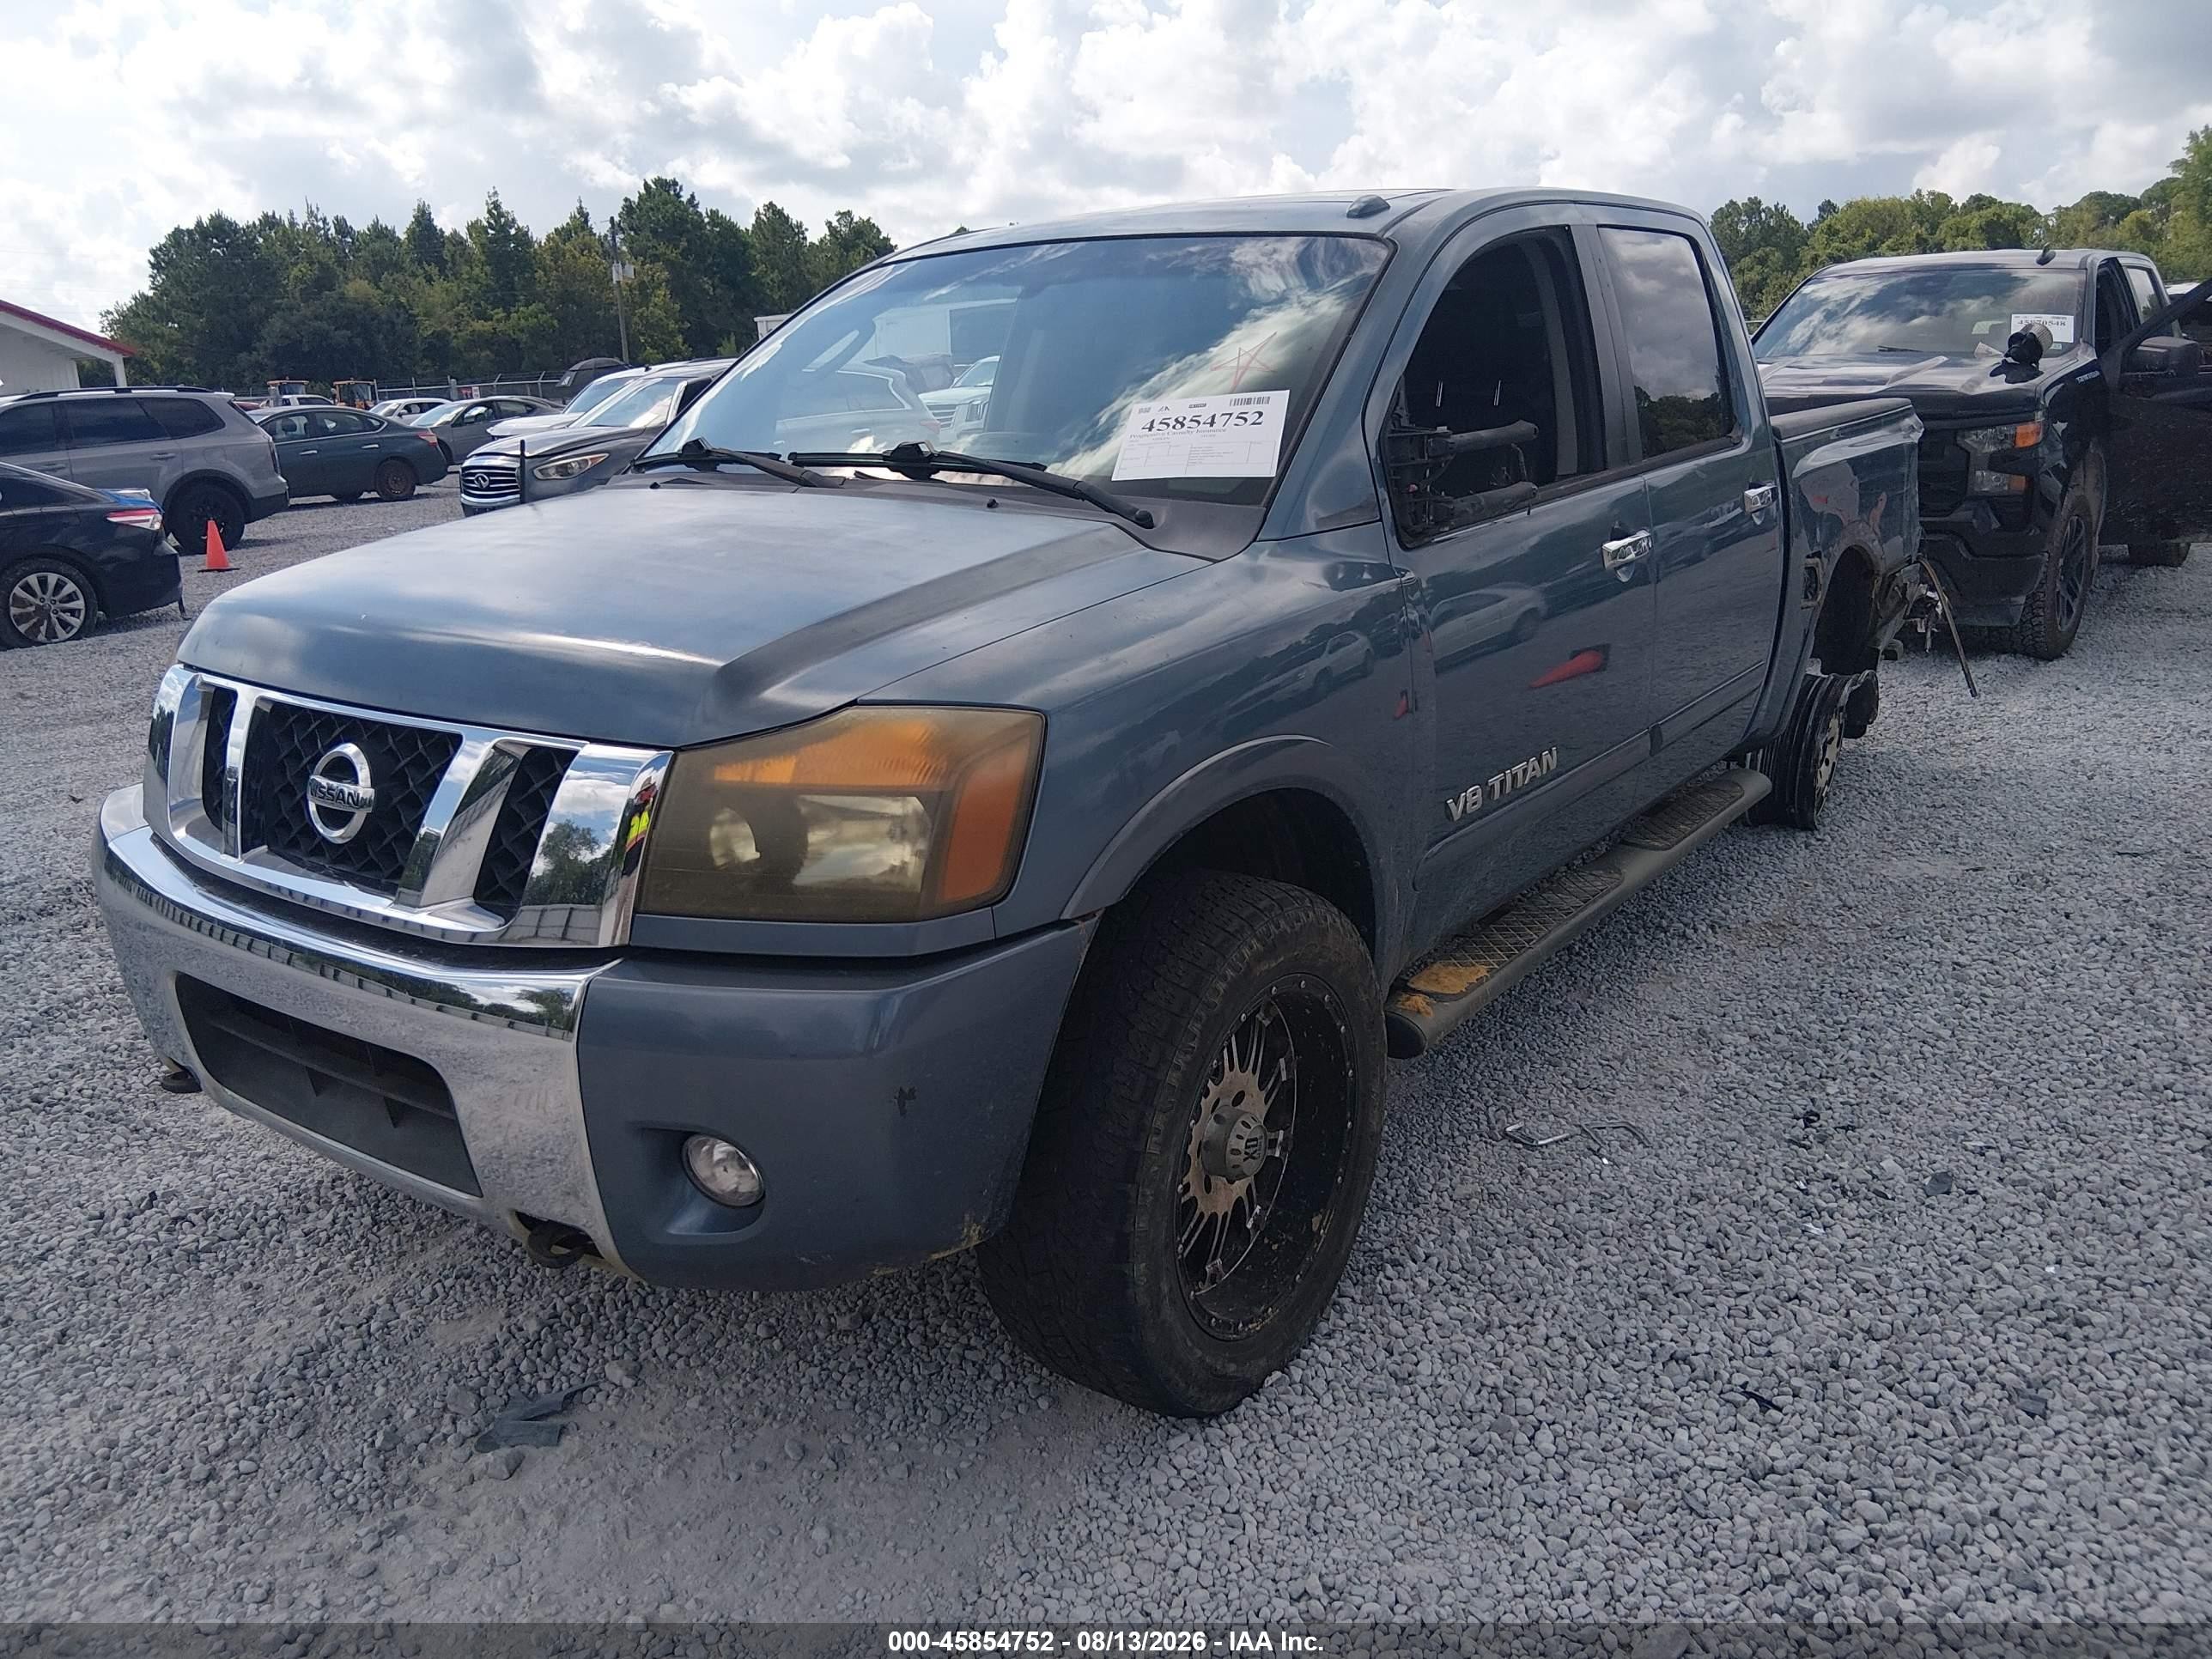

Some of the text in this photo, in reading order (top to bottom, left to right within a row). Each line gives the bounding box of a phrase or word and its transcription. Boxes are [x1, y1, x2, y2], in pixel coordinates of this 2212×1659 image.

[1141, 410, 1264, 432] 45854752
[1446, 746, 1558, 821] V8 TITAN
[1243, 1136, 1259, 1163] XD
